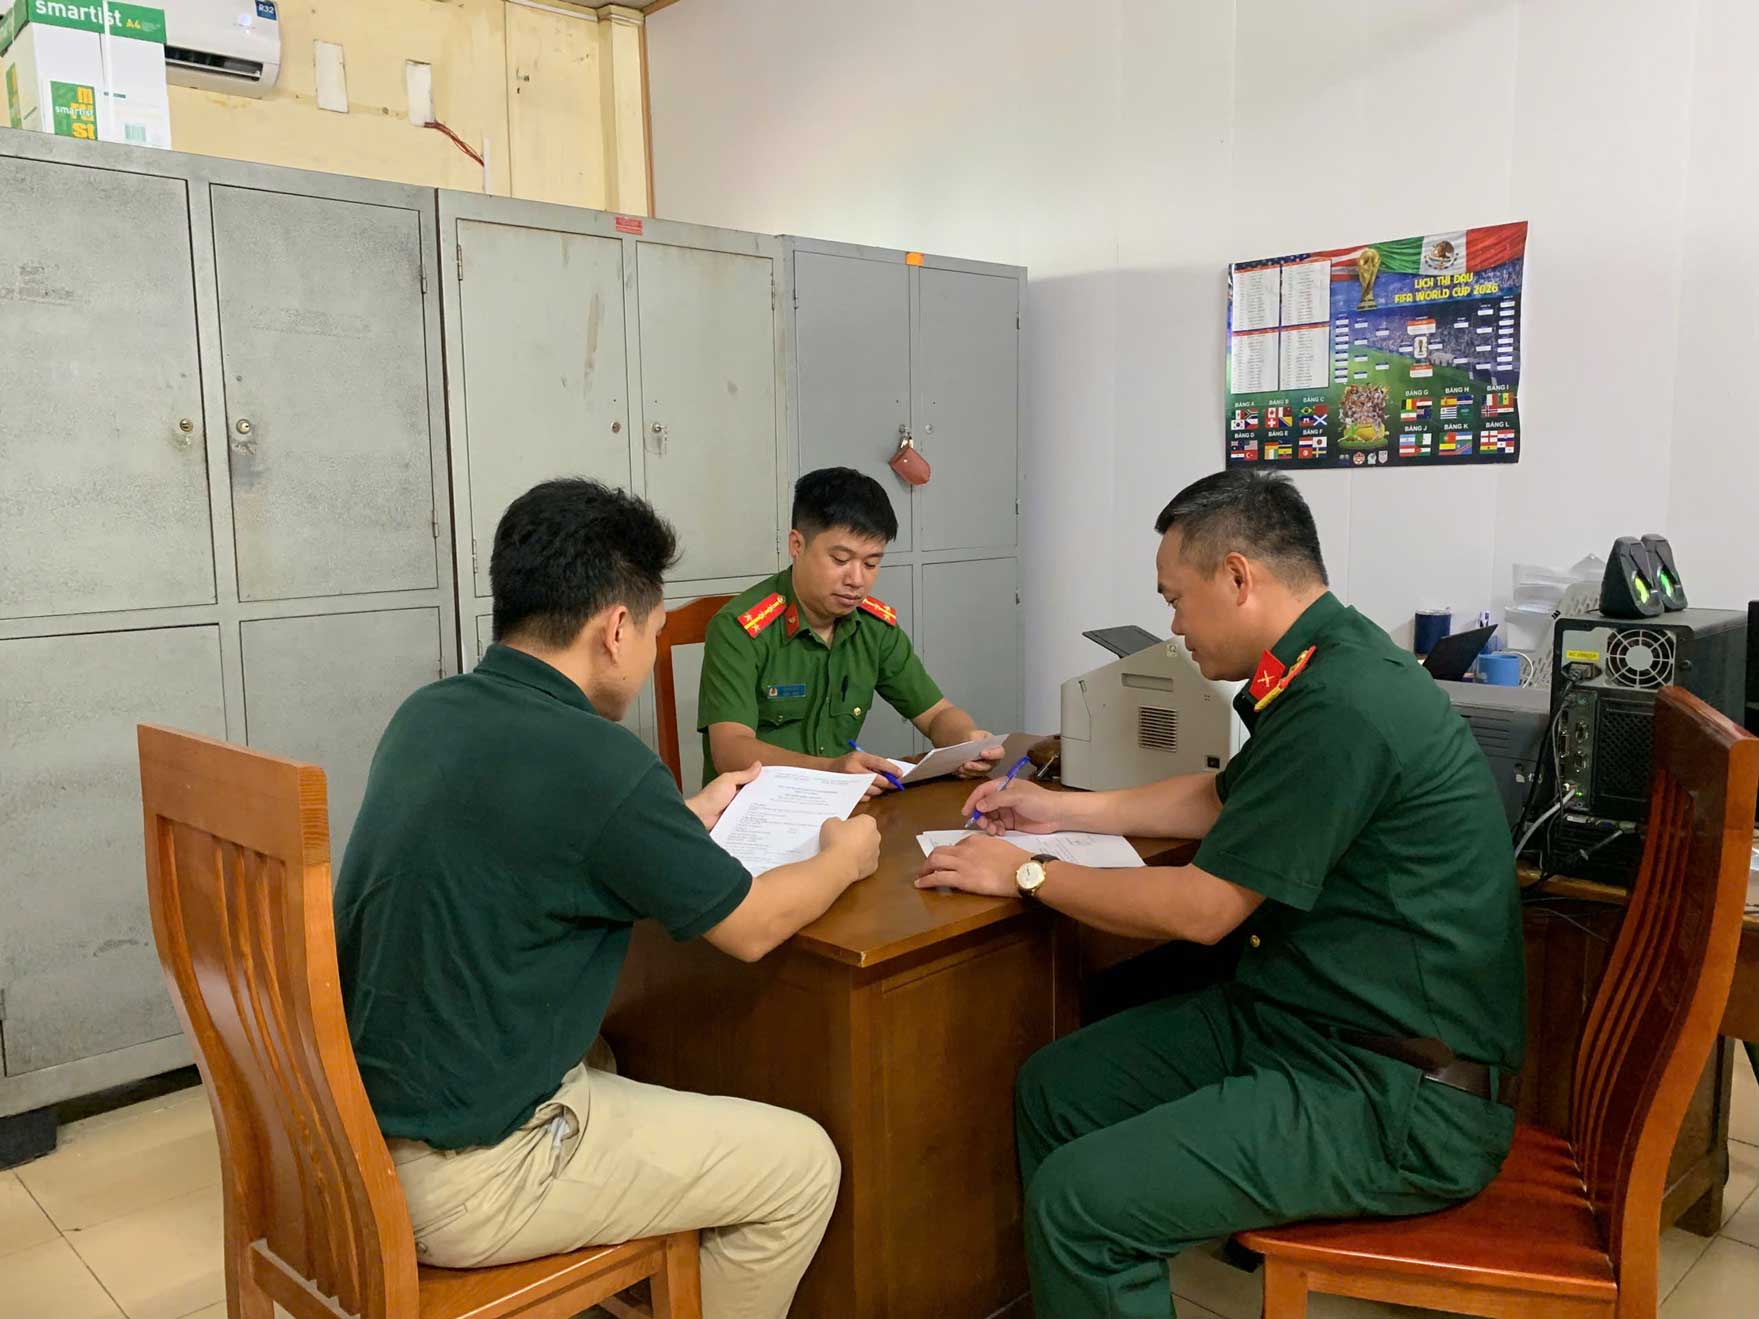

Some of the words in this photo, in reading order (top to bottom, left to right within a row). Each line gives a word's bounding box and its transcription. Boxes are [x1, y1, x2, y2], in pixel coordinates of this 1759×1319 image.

[35, 0, 122, 27] smartist
[126, 18, 141, 30] A4
[258, 3, 274, 14] R32
[55, 105, 94, 117] smartist
[1394, 293, 1413, 304] FIFA
[1415, 288, 1450, 300] WORLD
[1452, 286, 1471, 297] CUP
[1473, 283, 1499, 295] 2026
